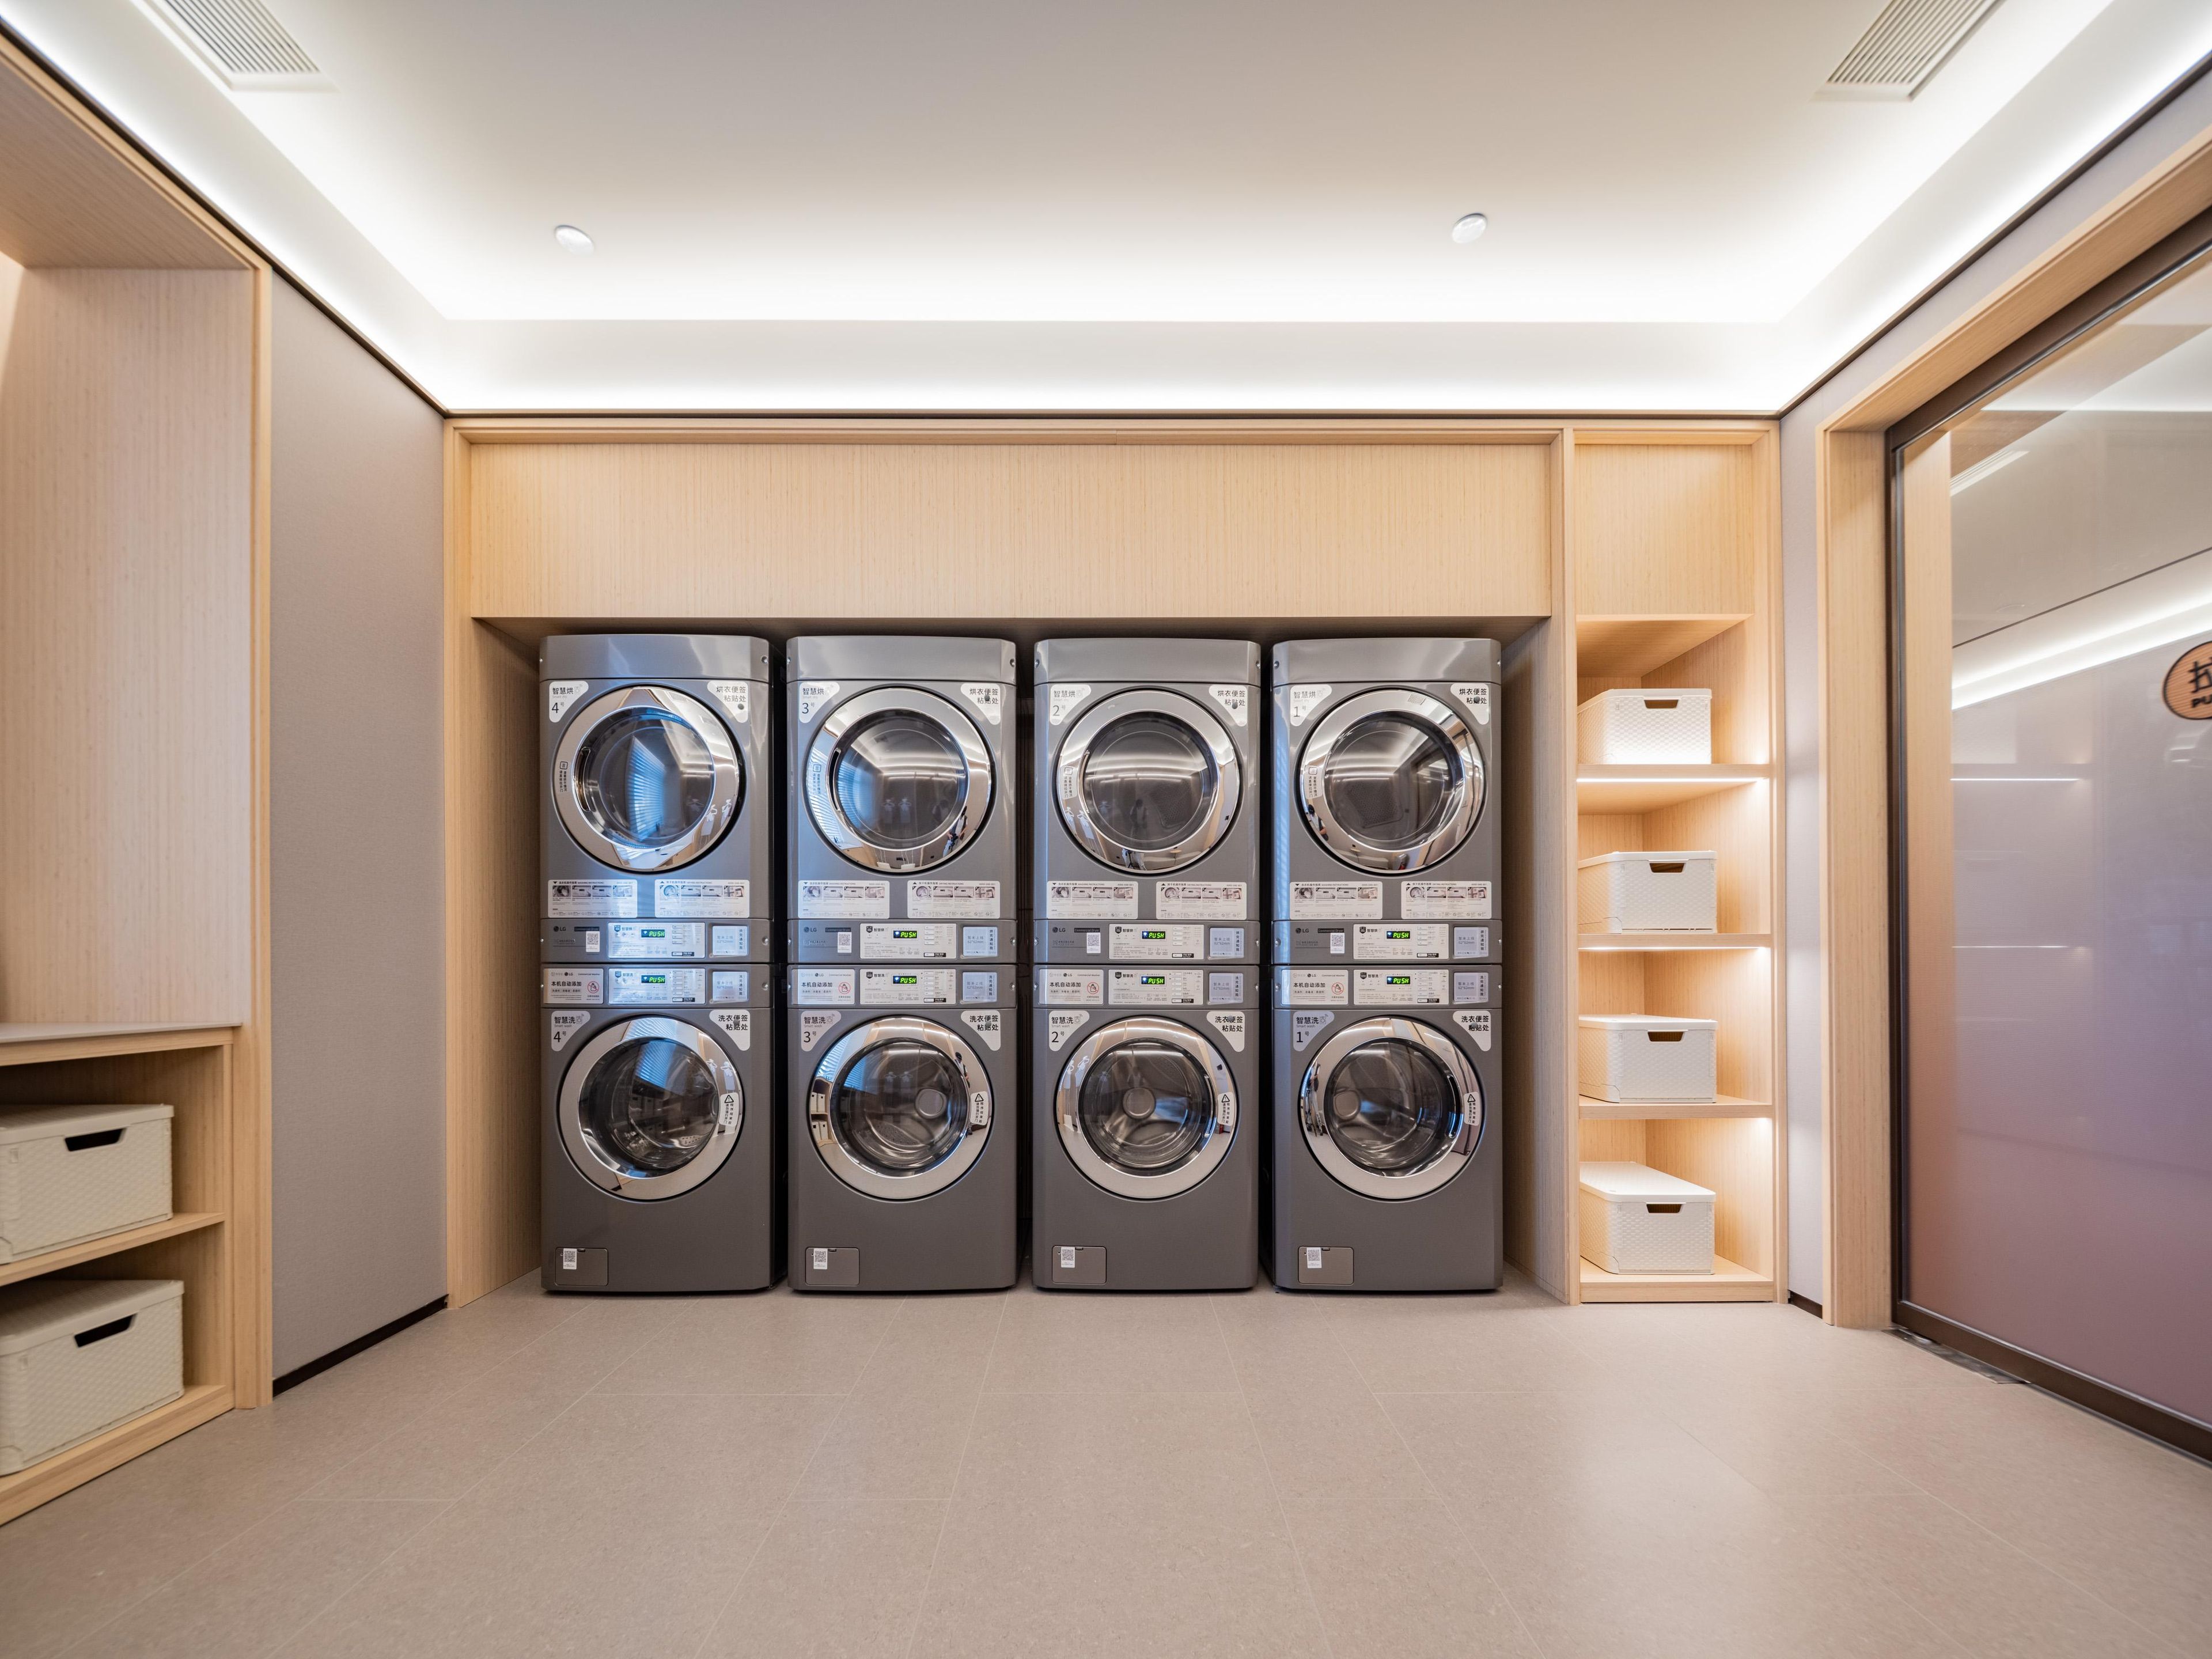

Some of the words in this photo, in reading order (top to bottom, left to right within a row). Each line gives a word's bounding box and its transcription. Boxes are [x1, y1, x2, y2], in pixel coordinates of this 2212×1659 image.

[552, 687, 573, 695] 智慧烘
[716, 685, 746, 694] 烘衣便签
[554, 1016, 576, 1024] 智慧洗
